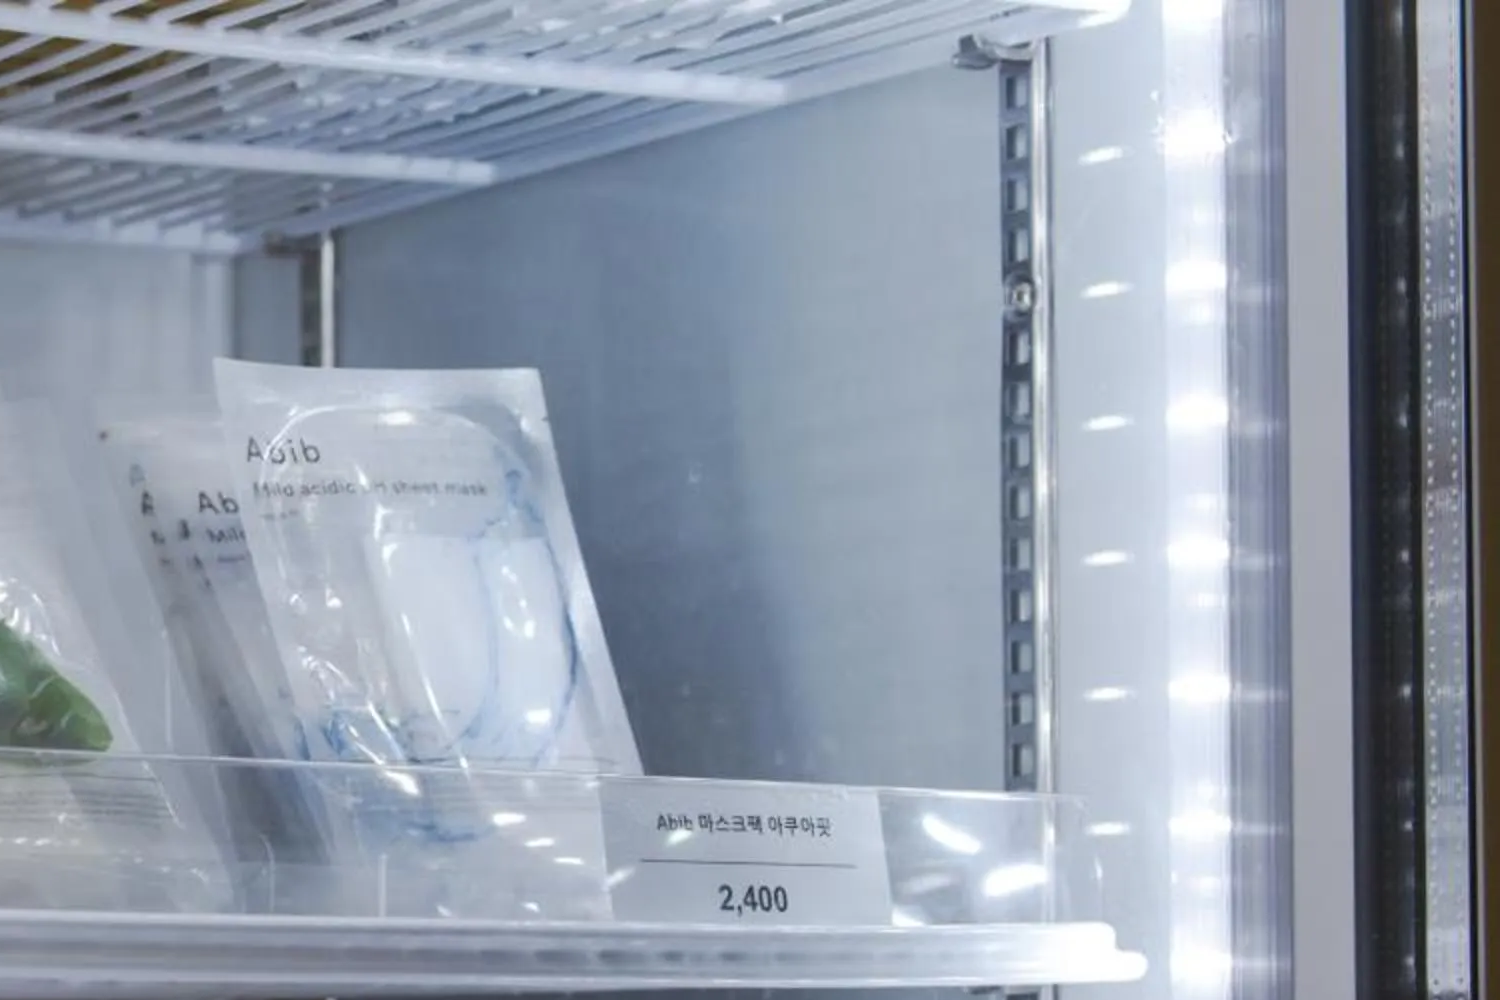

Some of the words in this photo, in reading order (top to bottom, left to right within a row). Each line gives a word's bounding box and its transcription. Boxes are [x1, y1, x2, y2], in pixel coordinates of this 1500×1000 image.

[300, 479, 357, 497] acidic
[698, 814, 763, 834] 마스크팩
[718, 884, 788, 916] 2,400
